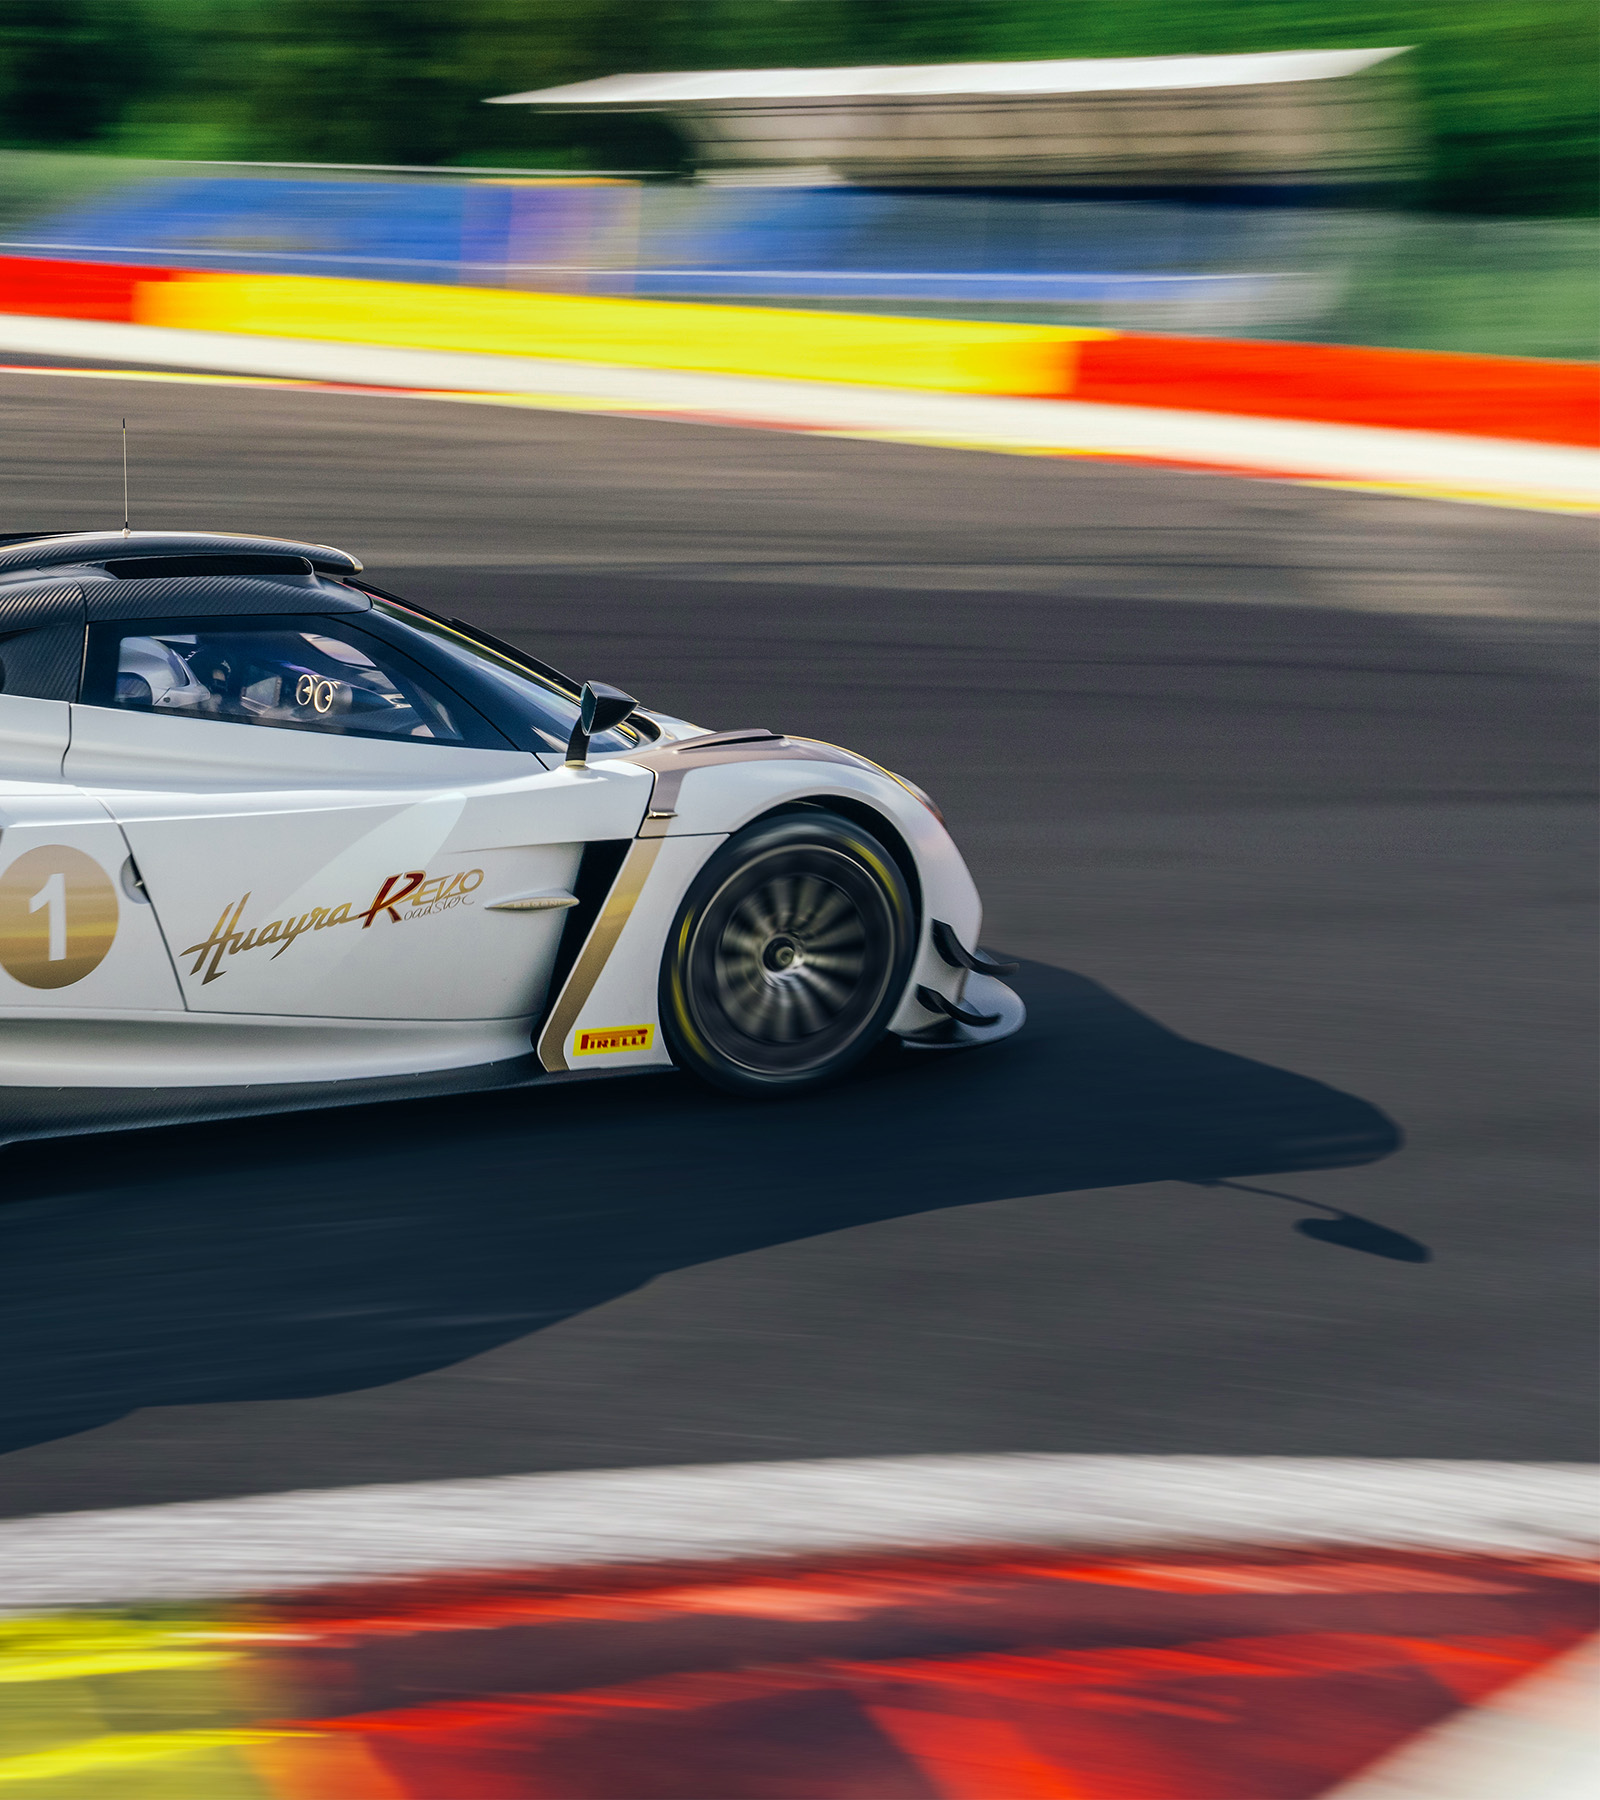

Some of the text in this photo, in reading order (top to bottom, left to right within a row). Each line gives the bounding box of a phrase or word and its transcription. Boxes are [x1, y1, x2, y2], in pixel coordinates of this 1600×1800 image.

[29, 873, 67, 961] 1
[179, 891, 358, 986] Huayra
[580, 1029, 648, 1050] PIRELLI
